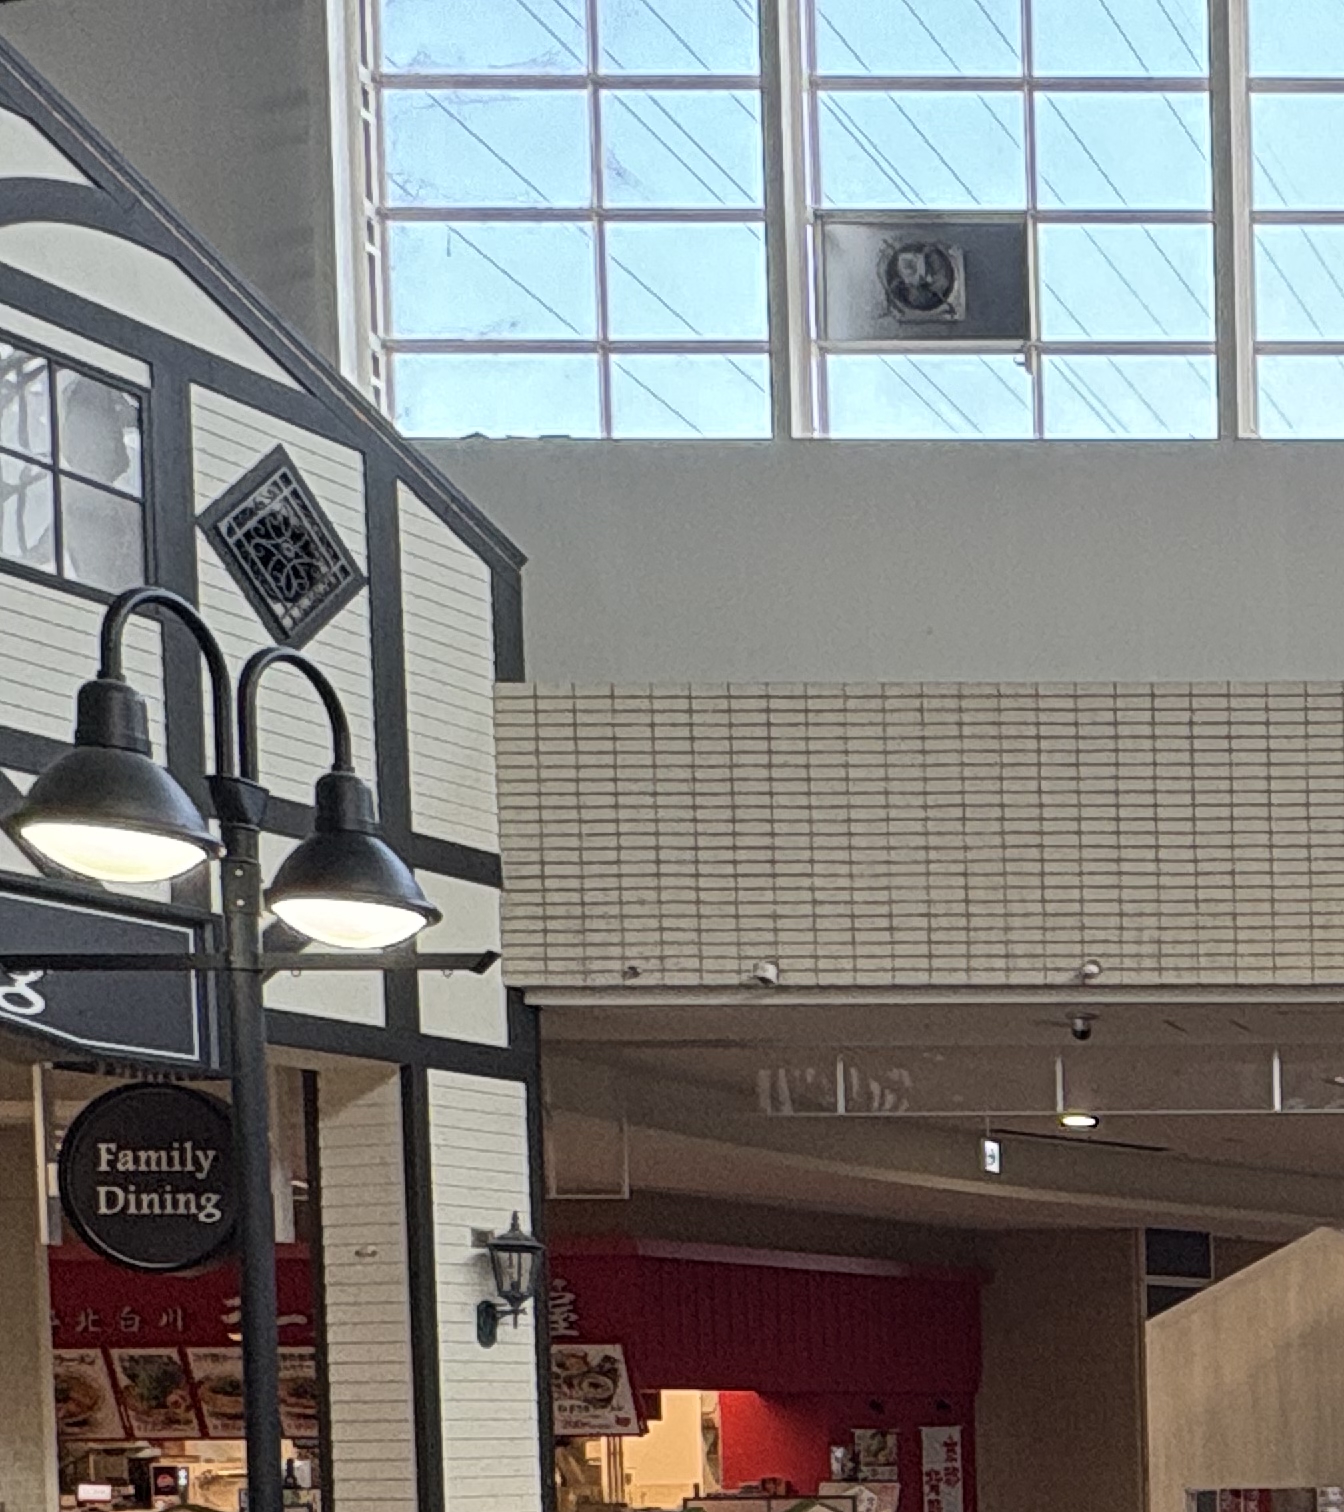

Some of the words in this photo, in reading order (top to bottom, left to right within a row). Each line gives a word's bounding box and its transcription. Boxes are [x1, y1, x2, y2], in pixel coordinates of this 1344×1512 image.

[97, 1141, 217, 1180] Family
[97, 1184, 222, 1224] Dining
[51, 1307, 183, 1333] 北白川
